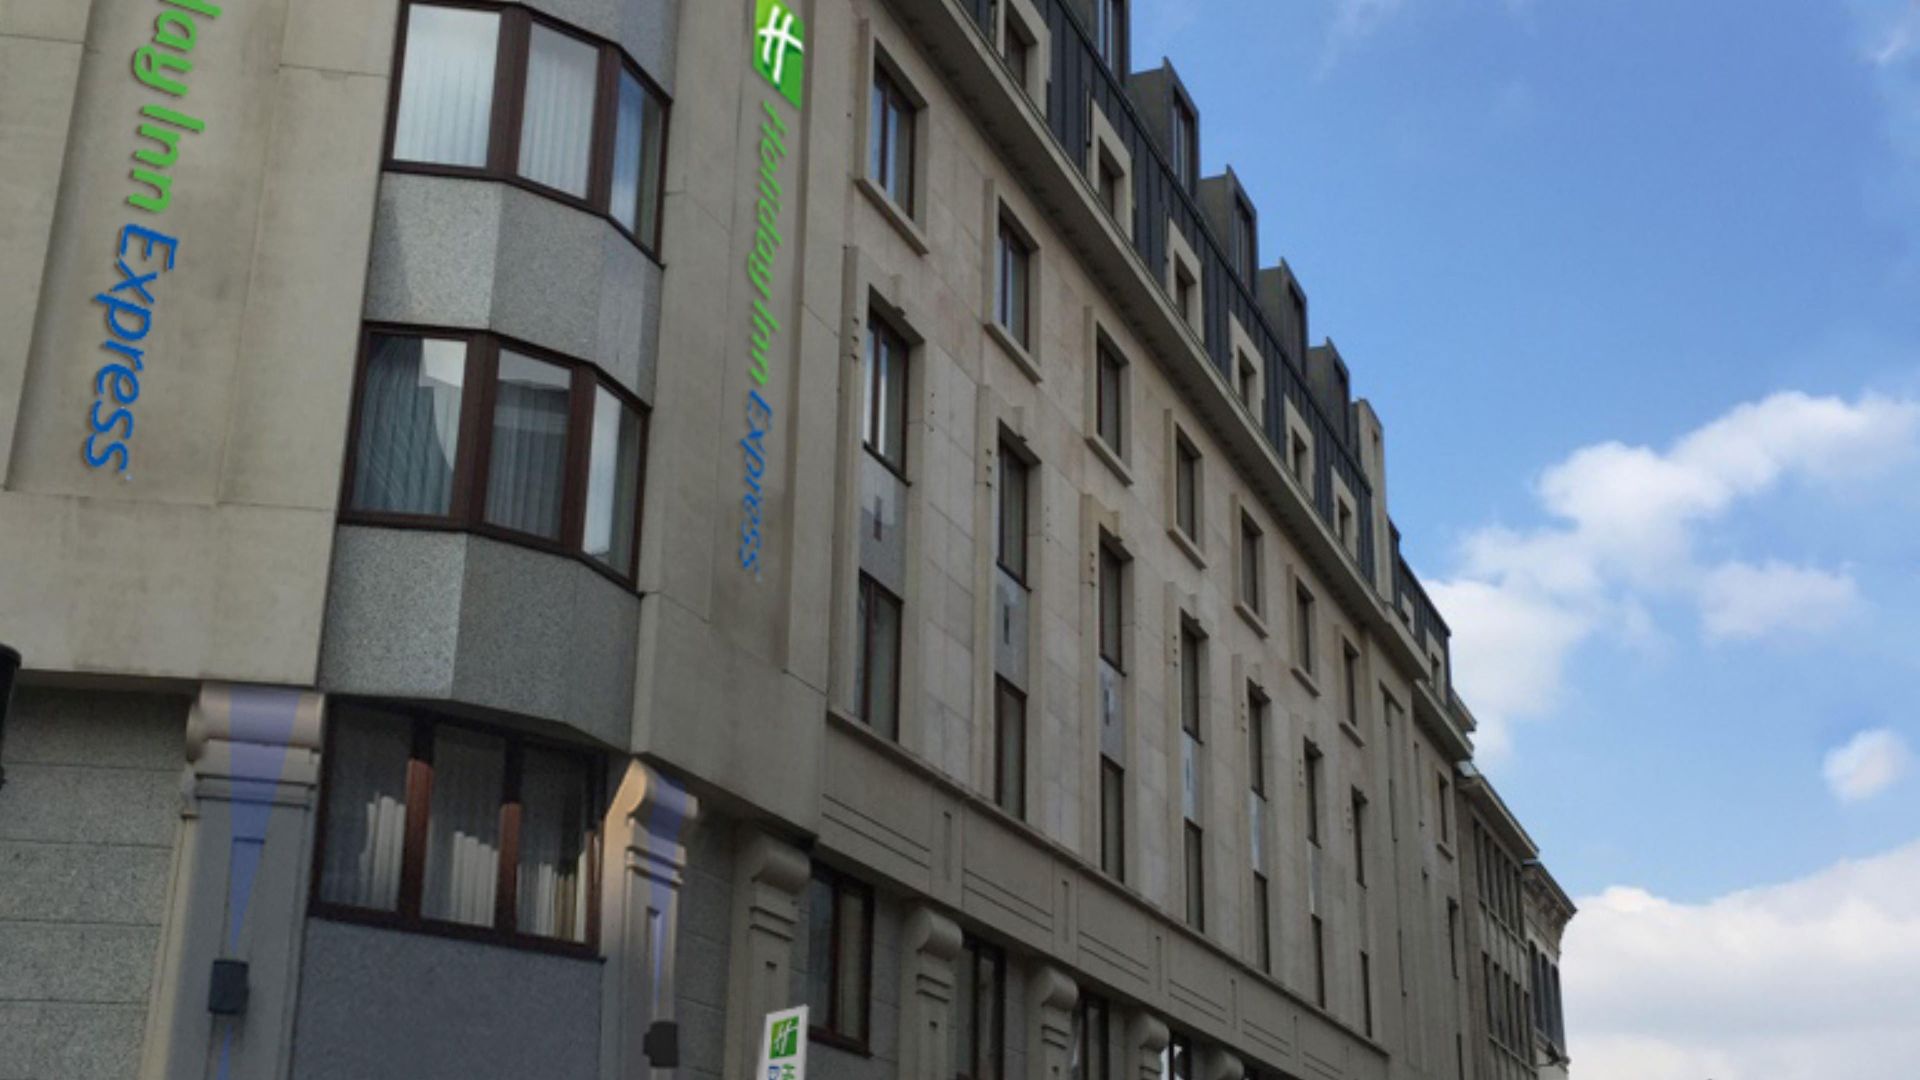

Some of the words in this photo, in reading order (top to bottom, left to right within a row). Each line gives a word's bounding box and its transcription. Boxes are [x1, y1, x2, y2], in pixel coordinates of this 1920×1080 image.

[127, 104, 205, 213] Inn
[747, 100, 790, 300] Holiday
[85, 223, 178, 472] Express
[749, 299, 781, 385] Inn
[739, 389, 773, 573] Express
